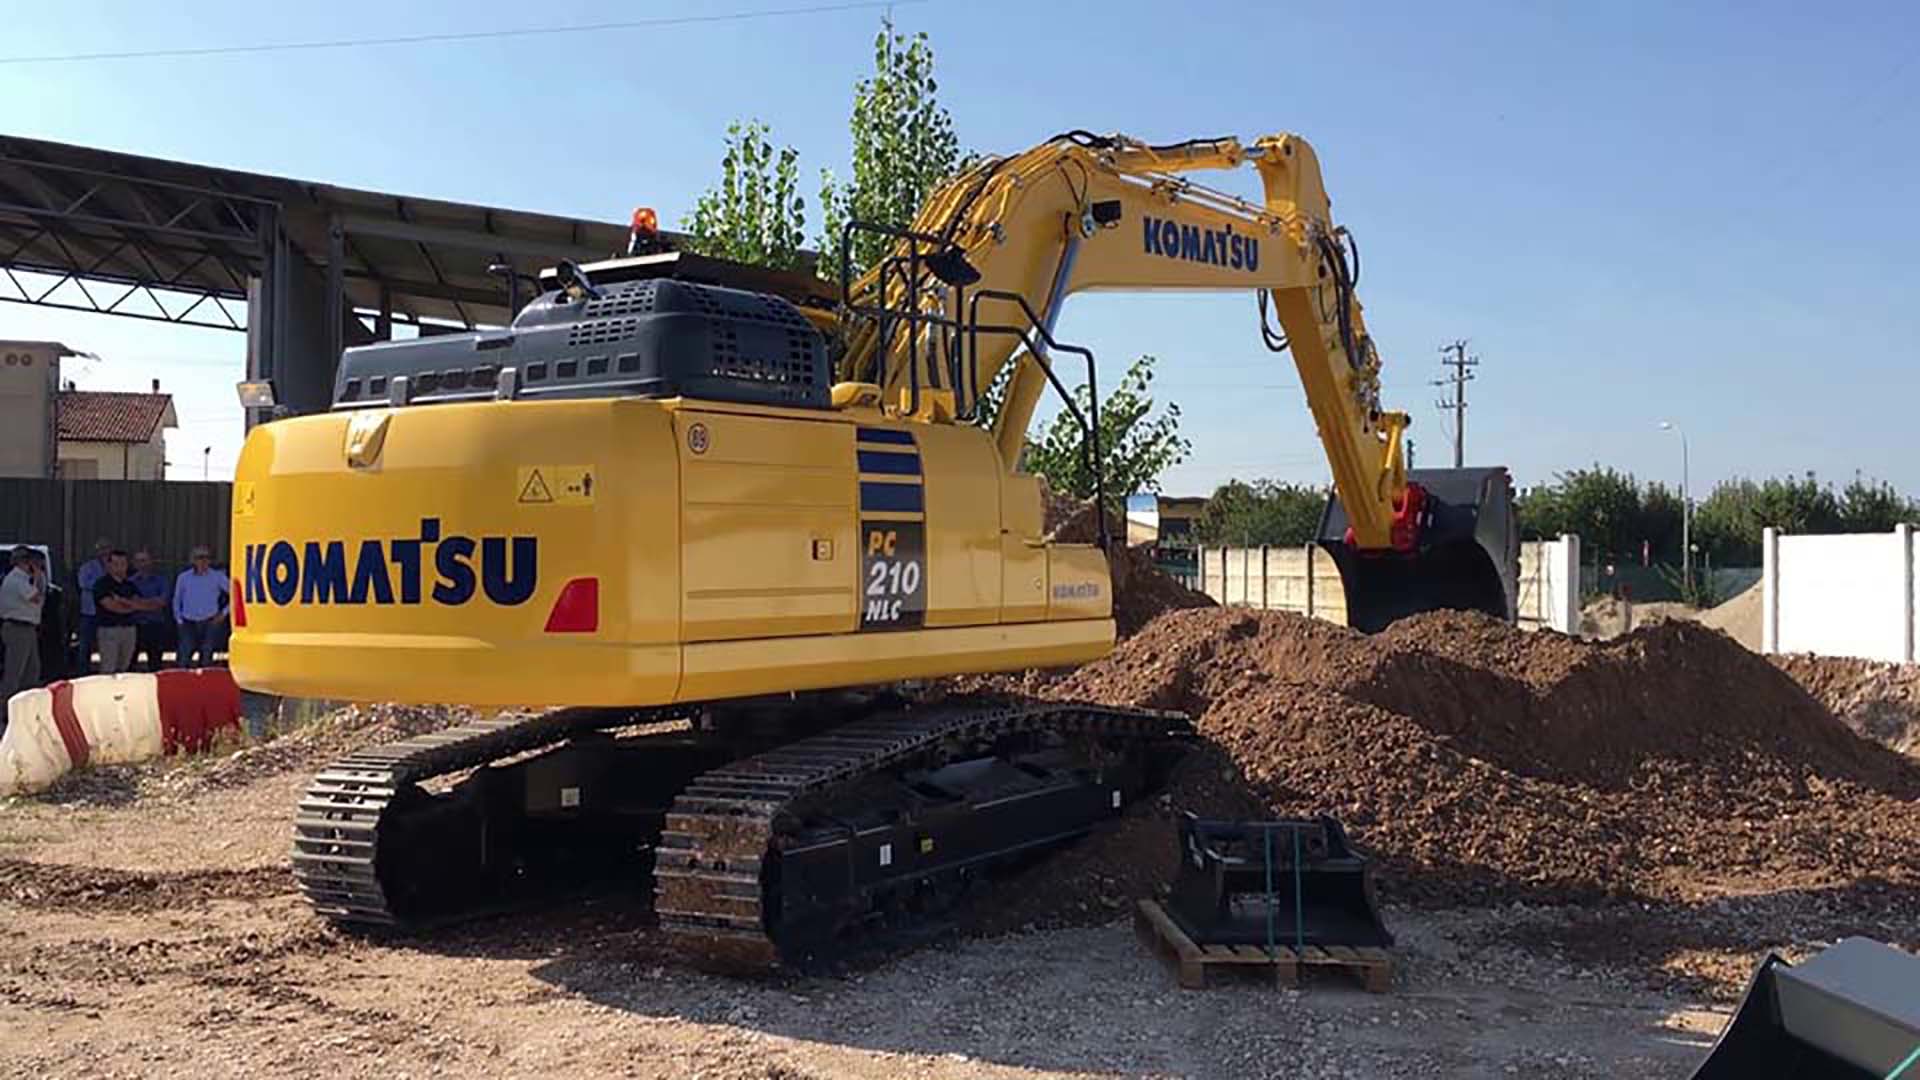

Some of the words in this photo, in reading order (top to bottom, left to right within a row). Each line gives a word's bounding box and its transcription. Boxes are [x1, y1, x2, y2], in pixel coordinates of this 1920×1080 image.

[1143, 217, 1258, 272] KOMATSU
[867, 530, 897, 557] PC
[245, 518, 538, 605] KOMATSU
[866, 560, 920, 595] 210
[865, 600, 902, 621] NLC
